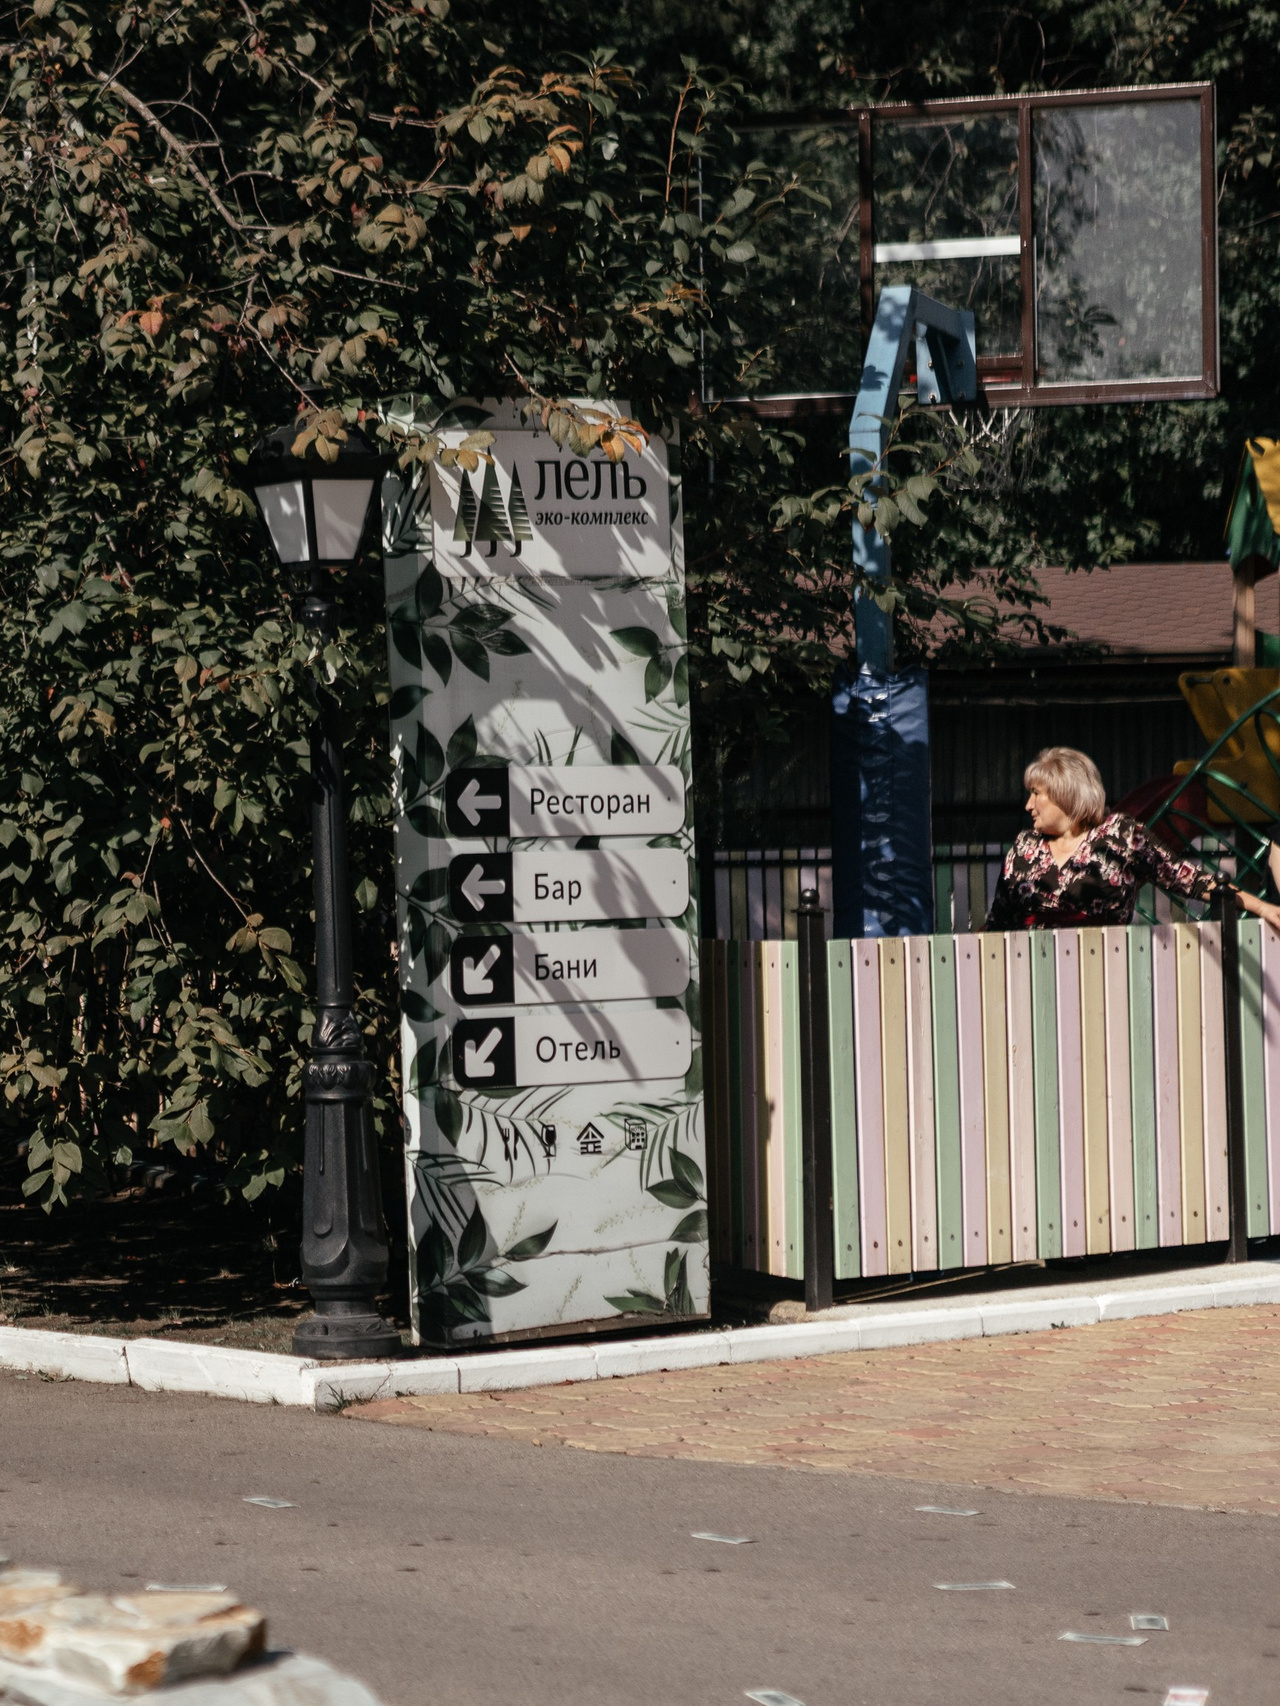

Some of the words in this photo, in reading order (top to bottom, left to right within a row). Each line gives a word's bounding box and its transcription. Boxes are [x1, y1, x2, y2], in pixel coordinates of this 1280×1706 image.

[535, 510, 649, 526] эко-комплекс
[530, 787, 650, 820] Ресторан
[534, 873, 582, 906] Бар
[534, 953, 597, 981] Бани
[536, 1036, 621, 1063] Отель
